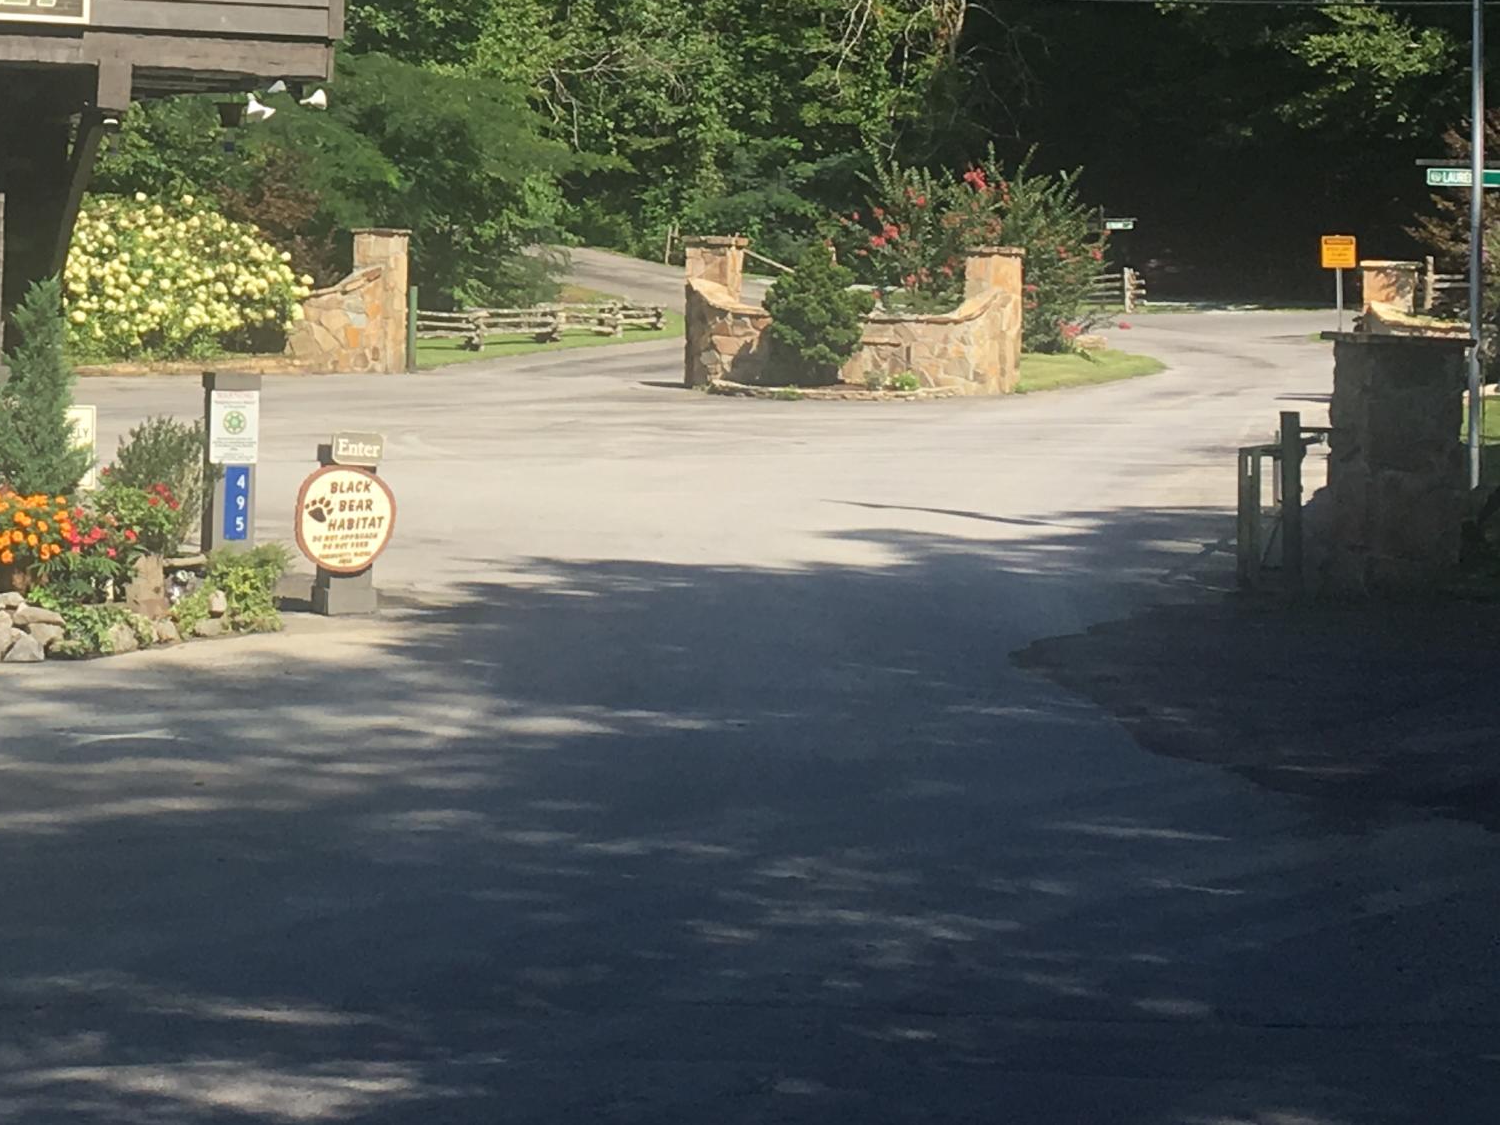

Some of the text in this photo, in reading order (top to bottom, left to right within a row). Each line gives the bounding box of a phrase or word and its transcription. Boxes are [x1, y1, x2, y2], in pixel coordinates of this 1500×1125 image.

[1442, 171, 1473, 184] LAURE
[337, 437, 381, 458] Enter
[329, 480, 373, 495] BLACK
[338, 498, 374, 513] BEAR
[327, 515, 385, 532] HABITAT
[323, 534, 339, 542] NOT
